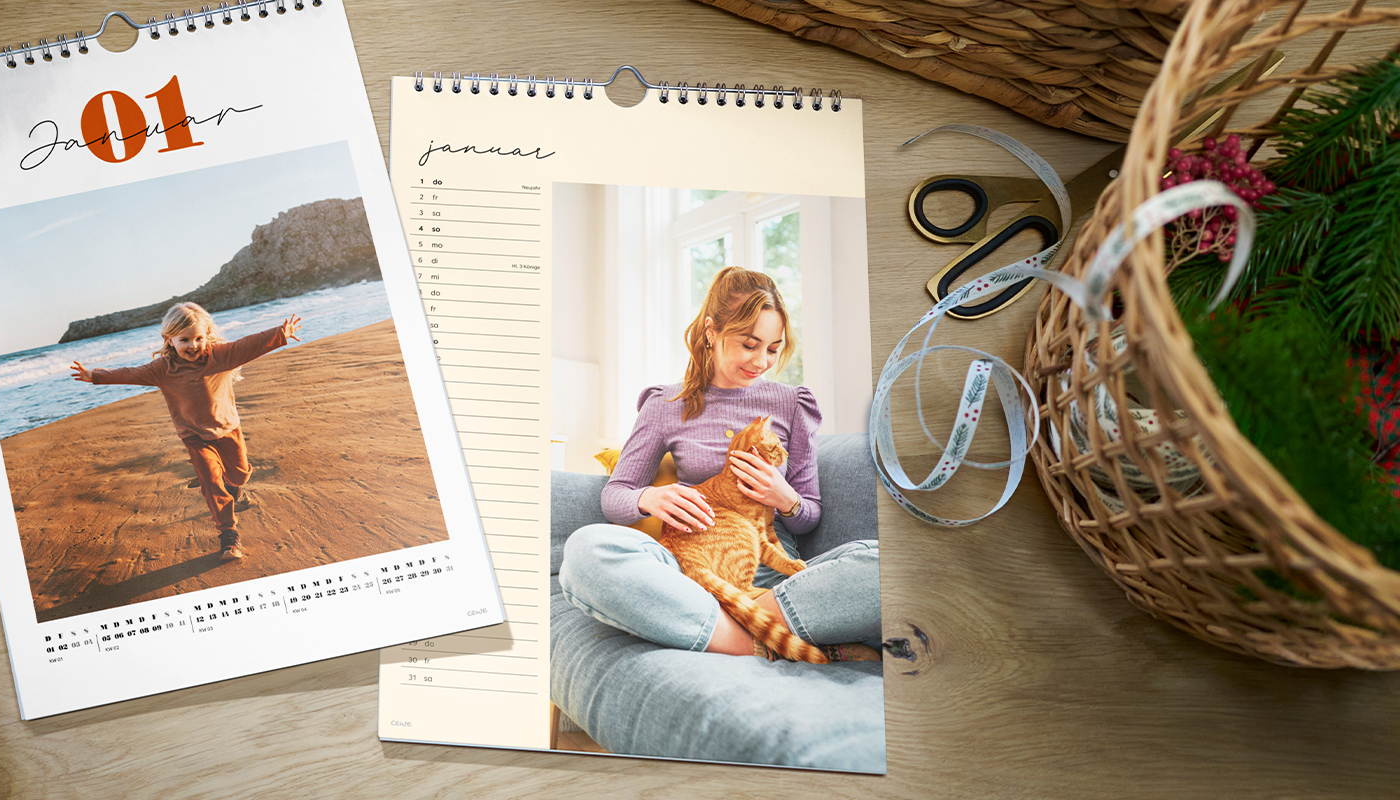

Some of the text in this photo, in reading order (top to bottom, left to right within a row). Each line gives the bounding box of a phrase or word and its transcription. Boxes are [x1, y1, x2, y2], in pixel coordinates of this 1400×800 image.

[20, 105, 262, 170] Januar
[81, 75, 204, 163] 01
[419, 140, 555, 166] januar
[467, 607, 488, 617] cewe
